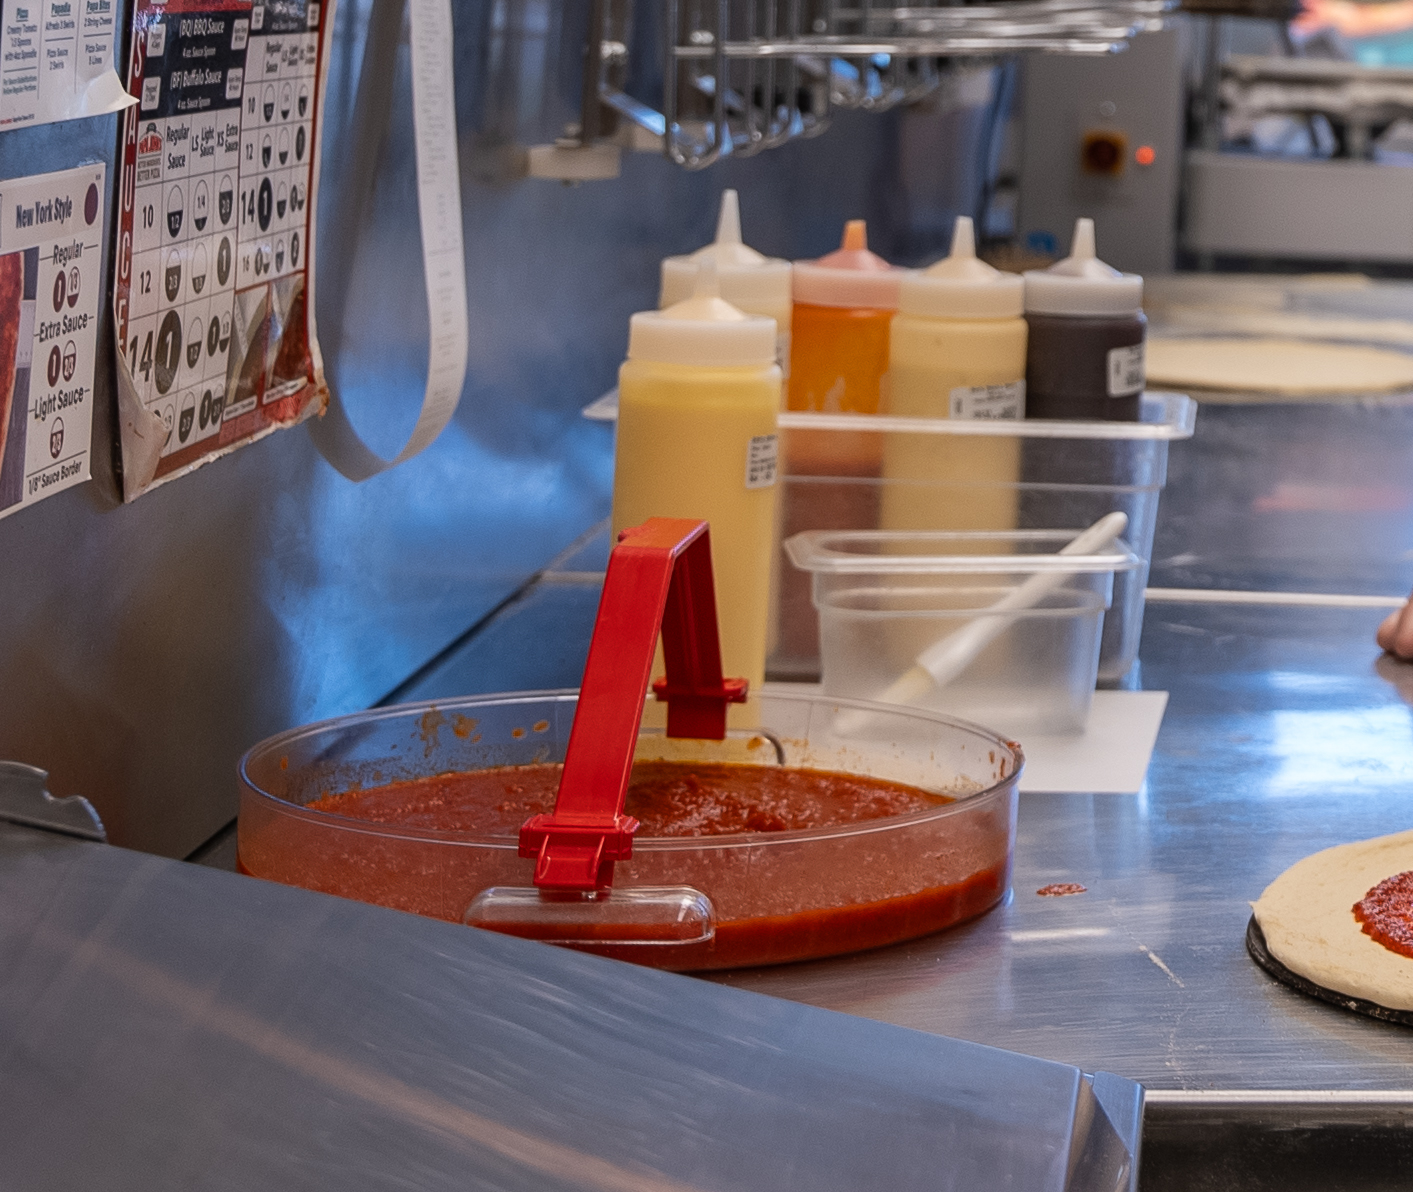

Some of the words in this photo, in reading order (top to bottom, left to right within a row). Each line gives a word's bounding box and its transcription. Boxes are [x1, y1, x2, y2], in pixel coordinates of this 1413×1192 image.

[179, 19, 192, 38] (BQ)
[193, 18, 206, 36] BBQ
[206, 18, 225, 34] Sauce
[183, 68, 205, 88] Buffalo
[205, 68, 222, 85] Sauce
[166, 123, 190, 146] Regular
[201, 126, 215, 143] Light
[226, 123, 239, 139] Extra
[191, 134, 199, 152] LS
[217, 130, 225, 148] XS
[167, 152, 186, 170] Sauce
[200, 142, 215, 158] Sauce
[225, 140, 239, 154] Sauce
[16, 204, 34, 229] New
[35, 199, 53, 224] York
[54, 195, 73, 224] Style
[241, 188, 256, 226] 14
[262, 190, 268, 216] 1
[142, 204, 154, 230] 10
[171, 214, 180, 230] 1/2
[52, 238, 84, 268] Regular
[222, 250, 227, 272] 1
[58, 279, 62, 303] 1
[140, 270, 152, 295] 12
[39, 320, 62, 343] Extra
[62, 313, 88, 335] Sauce
[212, 327, 218, 346] 1
[129, 330, 153, 383] 14
[165, 330, 173, 370] 1
[52, 354, 57, 378] 1
[64, 356, 74, 378] 2/3
[34, 394, 57, 422] Light
[57, 386, 84, 410] Sauce
[52, 432, 62, 456] 2/3
[42, 470, 61, 489] Sauce
[61, 460, 82, 482] Border
